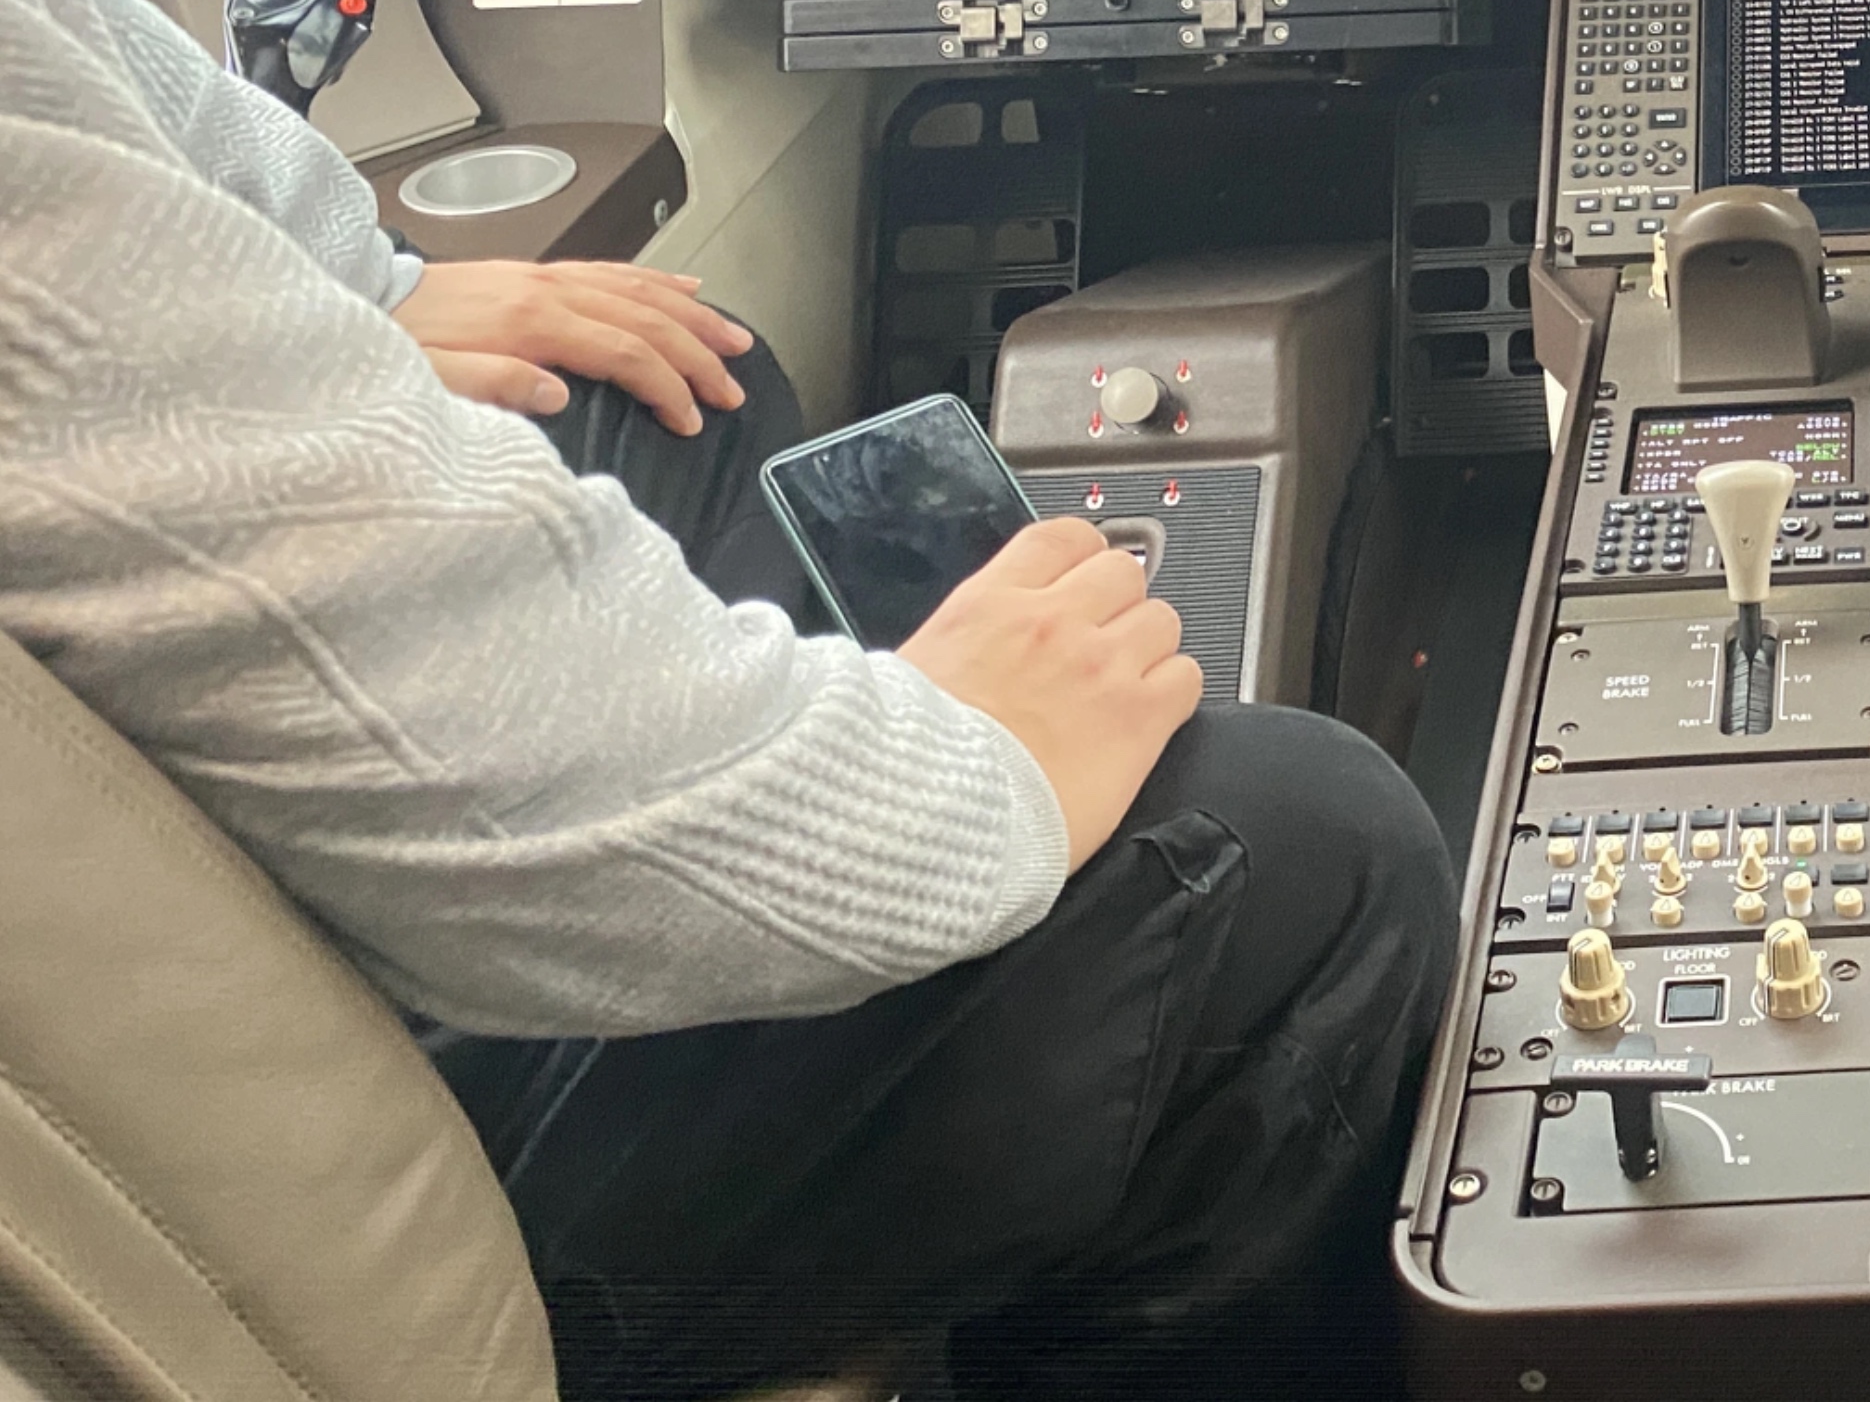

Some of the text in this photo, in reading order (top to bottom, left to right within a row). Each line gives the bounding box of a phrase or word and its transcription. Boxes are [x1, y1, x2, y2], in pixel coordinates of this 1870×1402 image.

[1606, 675, 1650, 686] SPEED
[1602, 687, 1649, 699] BRAKE
[1663, 947, 1731, 962] LIGHTING
[1675, 963, 1717, 975] FLOOR
[1572, 1058, 1690, 1072] PARK BRAKE
[1721, 1079, 1776, 1094] BRAKE
